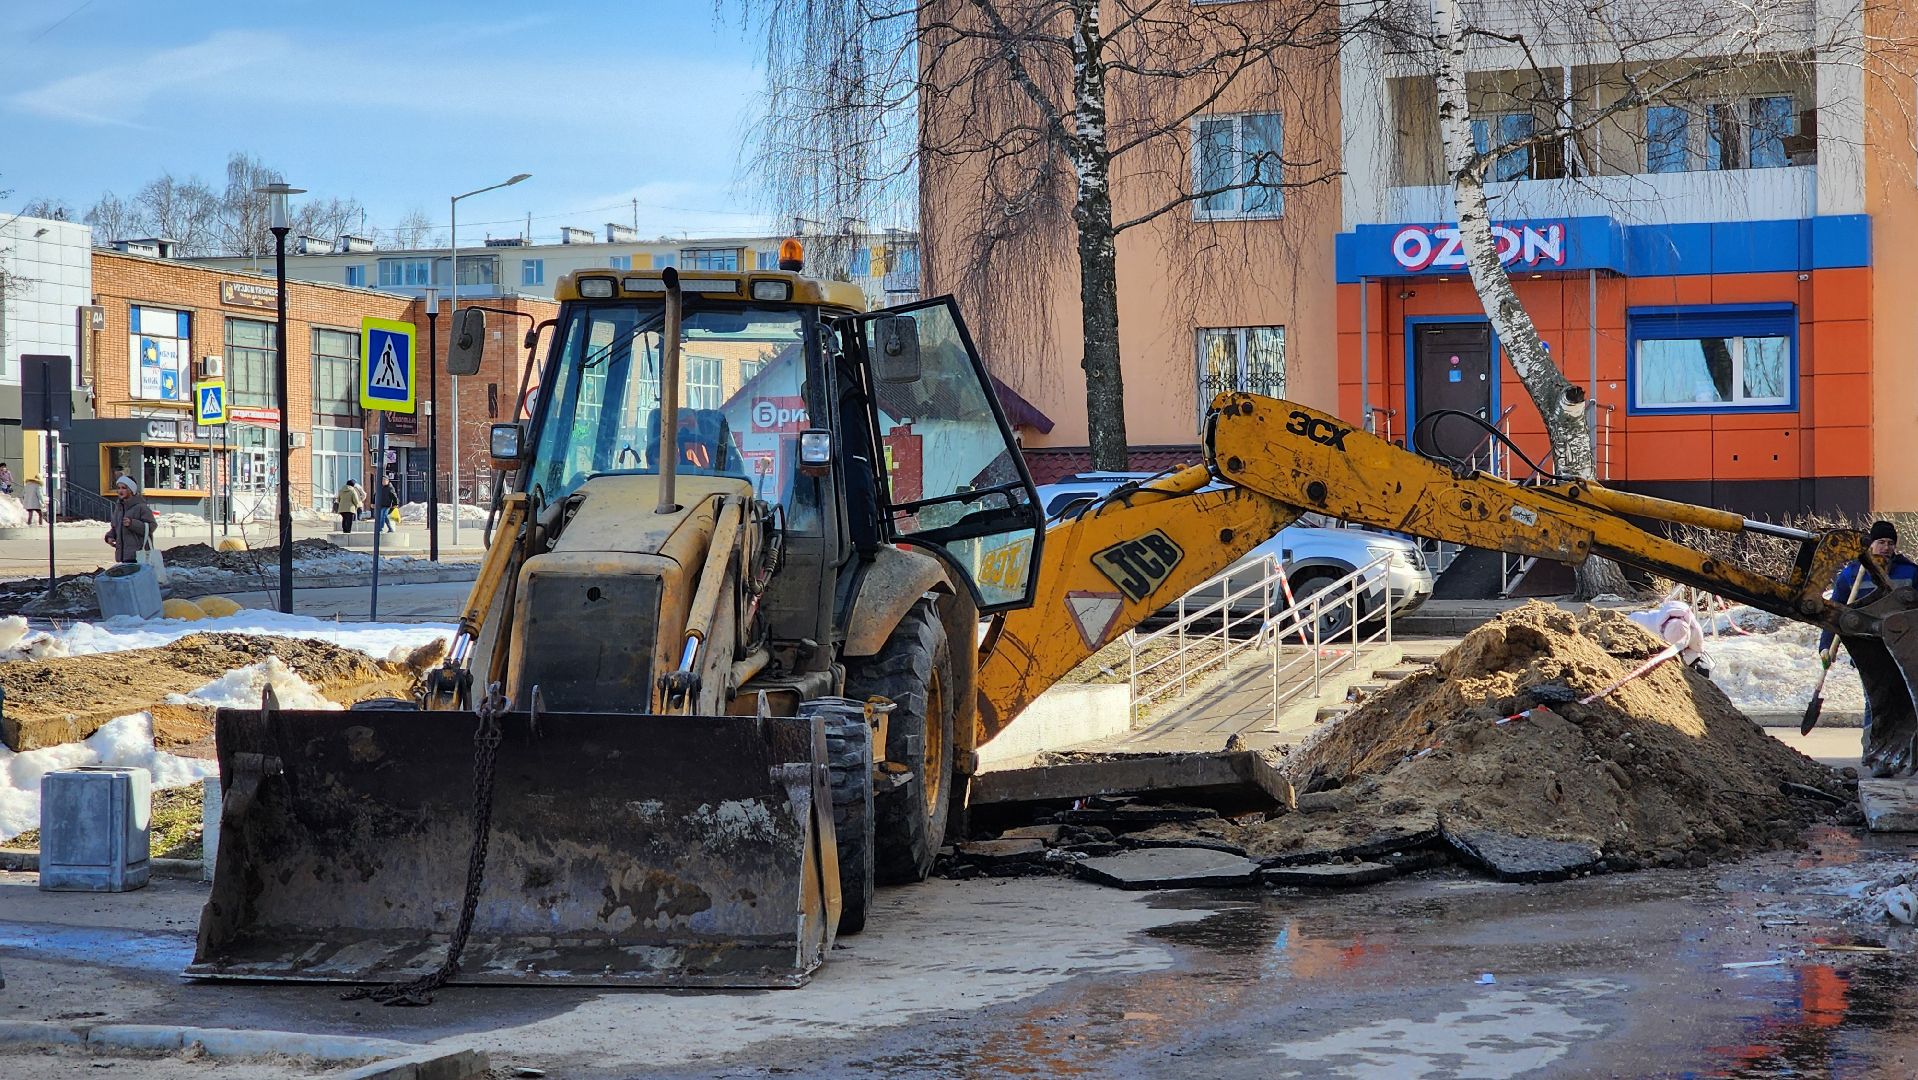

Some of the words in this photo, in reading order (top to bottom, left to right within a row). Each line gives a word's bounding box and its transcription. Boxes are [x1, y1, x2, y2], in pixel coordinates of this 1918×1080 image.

[1393, 225, 1563, 270] OZON
[1286, 411, 1352, 452] 3CX
[1104, 535, 1178, 599] JCB
